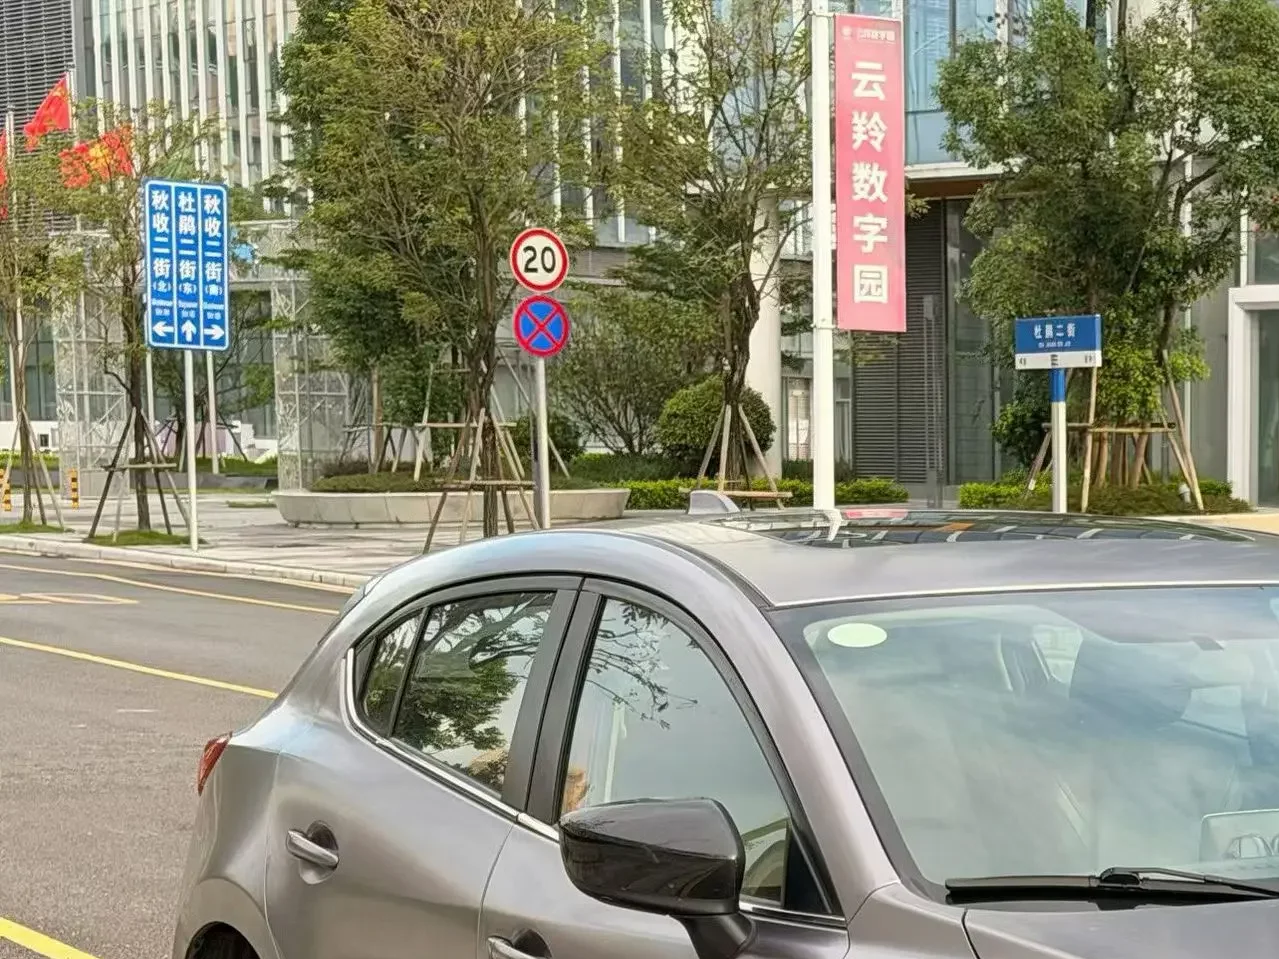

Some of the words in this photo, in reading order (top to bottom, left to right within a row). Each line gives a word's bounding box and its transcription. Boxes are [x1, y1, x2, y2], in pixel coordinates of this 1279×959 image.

[851, 61, 888, 303] 云羚数字园
[151, 189, 171, 279] 秋收二街
[203, 194, 222, 282] 秋收二街
[523, 245, 556, 273] 20
